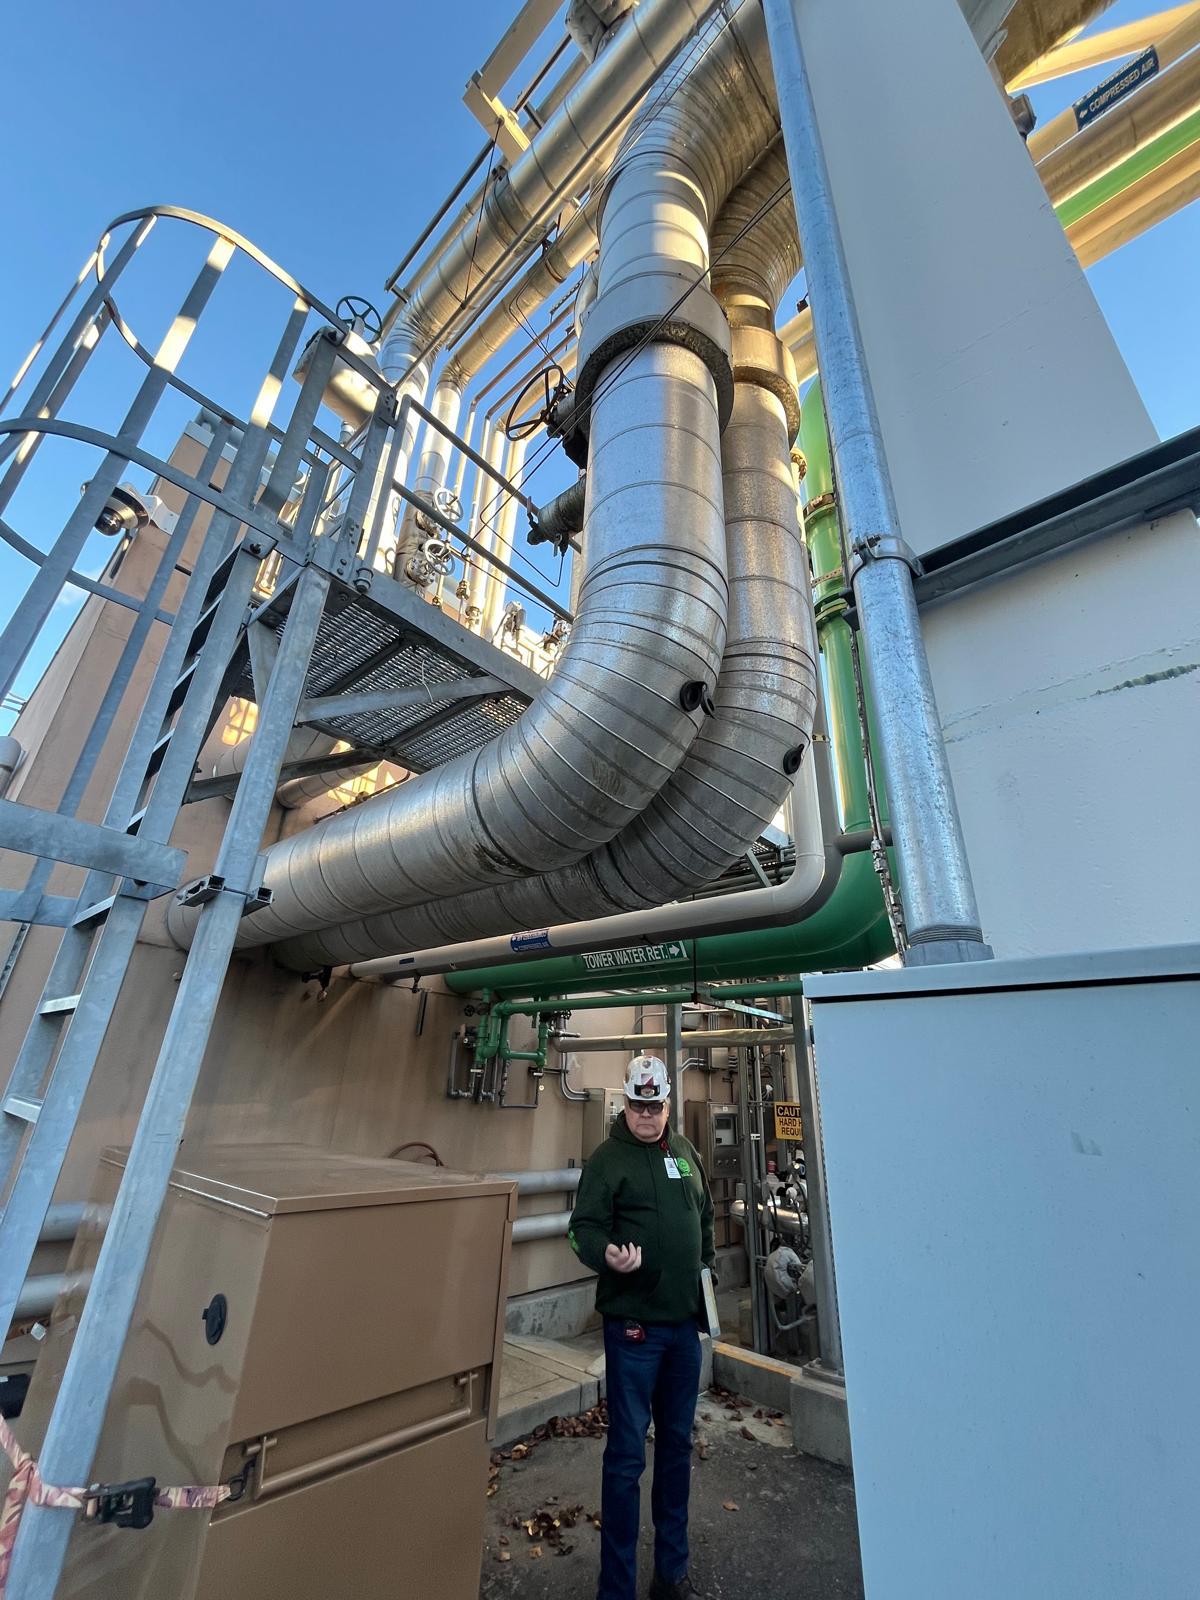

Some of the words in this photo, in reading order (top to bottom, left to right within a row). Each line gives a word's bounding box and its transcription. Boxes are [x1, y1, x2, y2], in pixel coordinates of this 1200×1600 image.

[1089, 69, 1140, 112] COMPRESSED
[1141, 57, 1154, 75] AIR
[583, 952, 616, 969] TOWER
[613, 947, 647, 965] WATER
[646, 944, 668, 962] RET.
[779, 1118, 796, 1127] HARD
